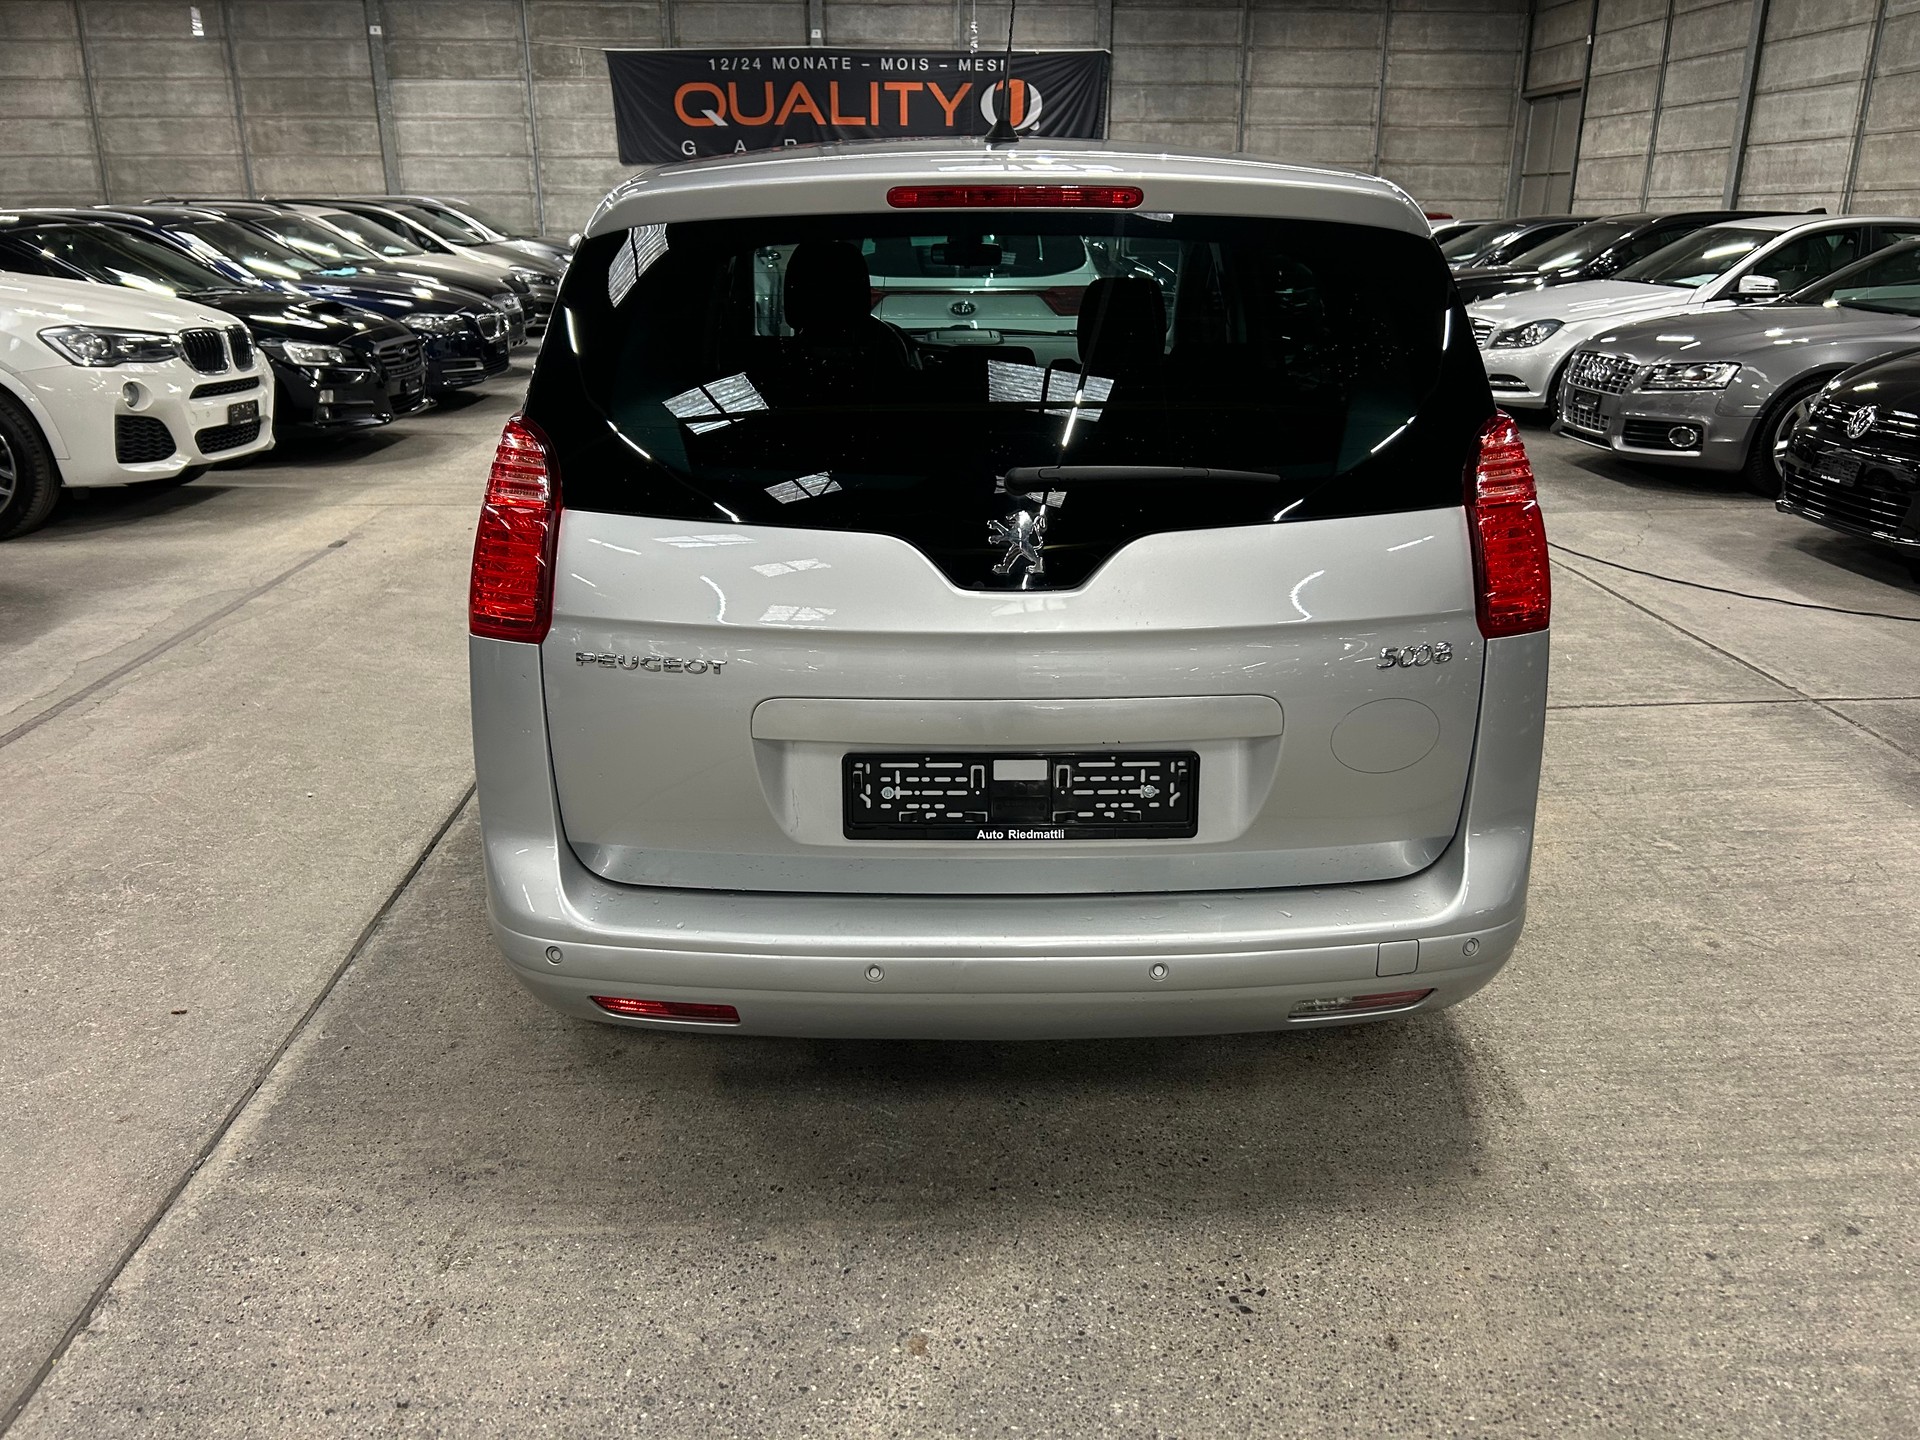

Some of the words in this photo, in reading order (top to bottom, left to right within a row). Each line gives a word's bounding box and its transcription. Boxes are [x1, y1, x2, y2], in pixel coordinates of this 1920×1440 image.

[708, 57, 762, 72] 12/24
[772, 56, 852, 71] MONATE
[881, 57, 929, 72] MOIS
[958, 58, 1005, 72] MESI
[674, 79, 974, 127] QUALITY
[575, 651, 728, 675] PEUGEOT
[1376, 641, 1454, 671] 5008
[976, 829, 1004, 840] Auto
[1008, 829, 1064, 840] Riedmattli
